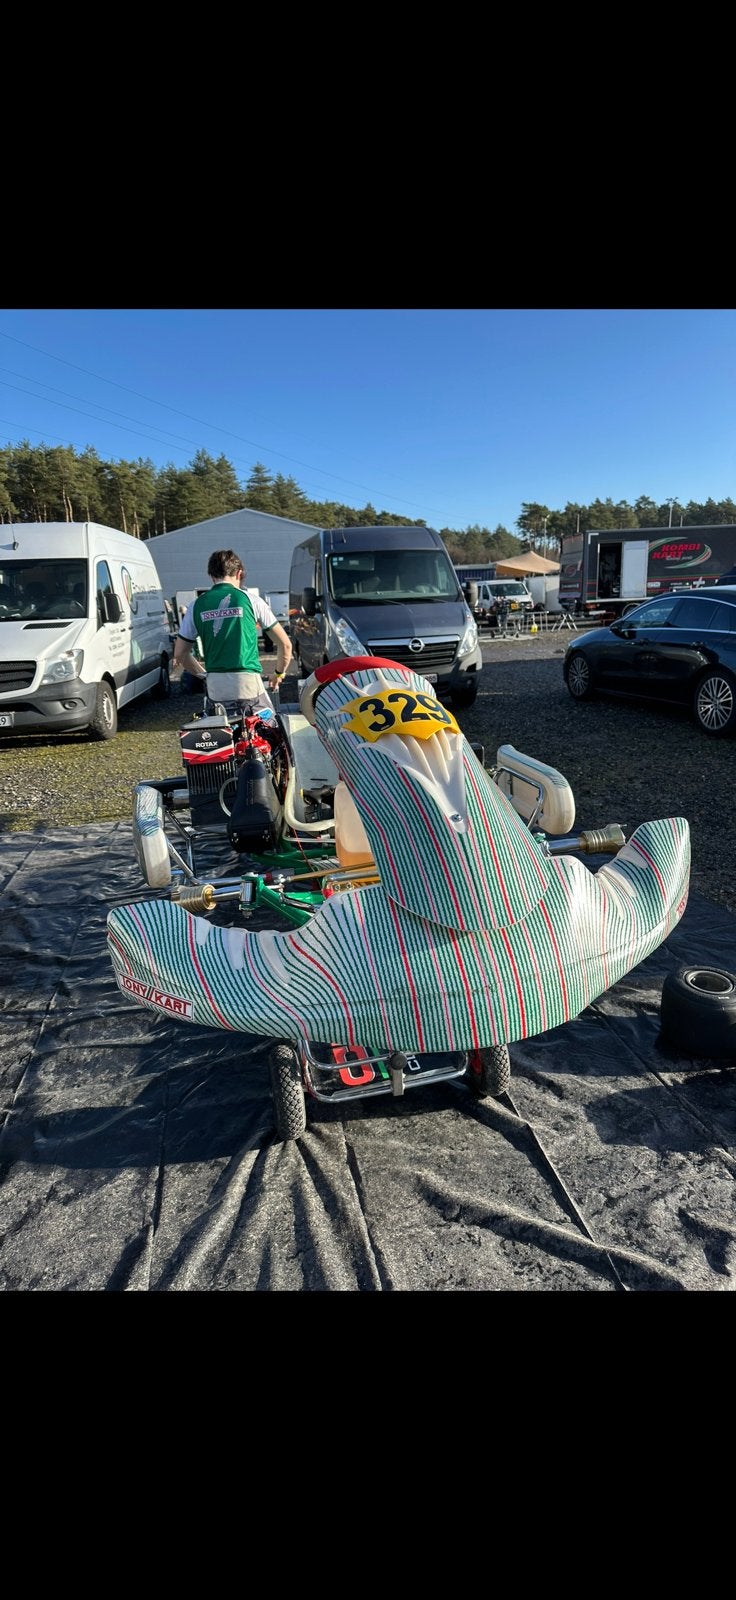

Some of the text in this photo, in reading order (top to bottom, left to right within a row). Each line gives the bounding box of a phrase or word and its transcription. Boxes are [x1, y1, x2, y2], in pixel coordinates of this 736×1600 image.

[652, 551, 684, 559] KART
[359, 693, 452, 732] 329
[120, 974, 192, 1015] TONY KART
